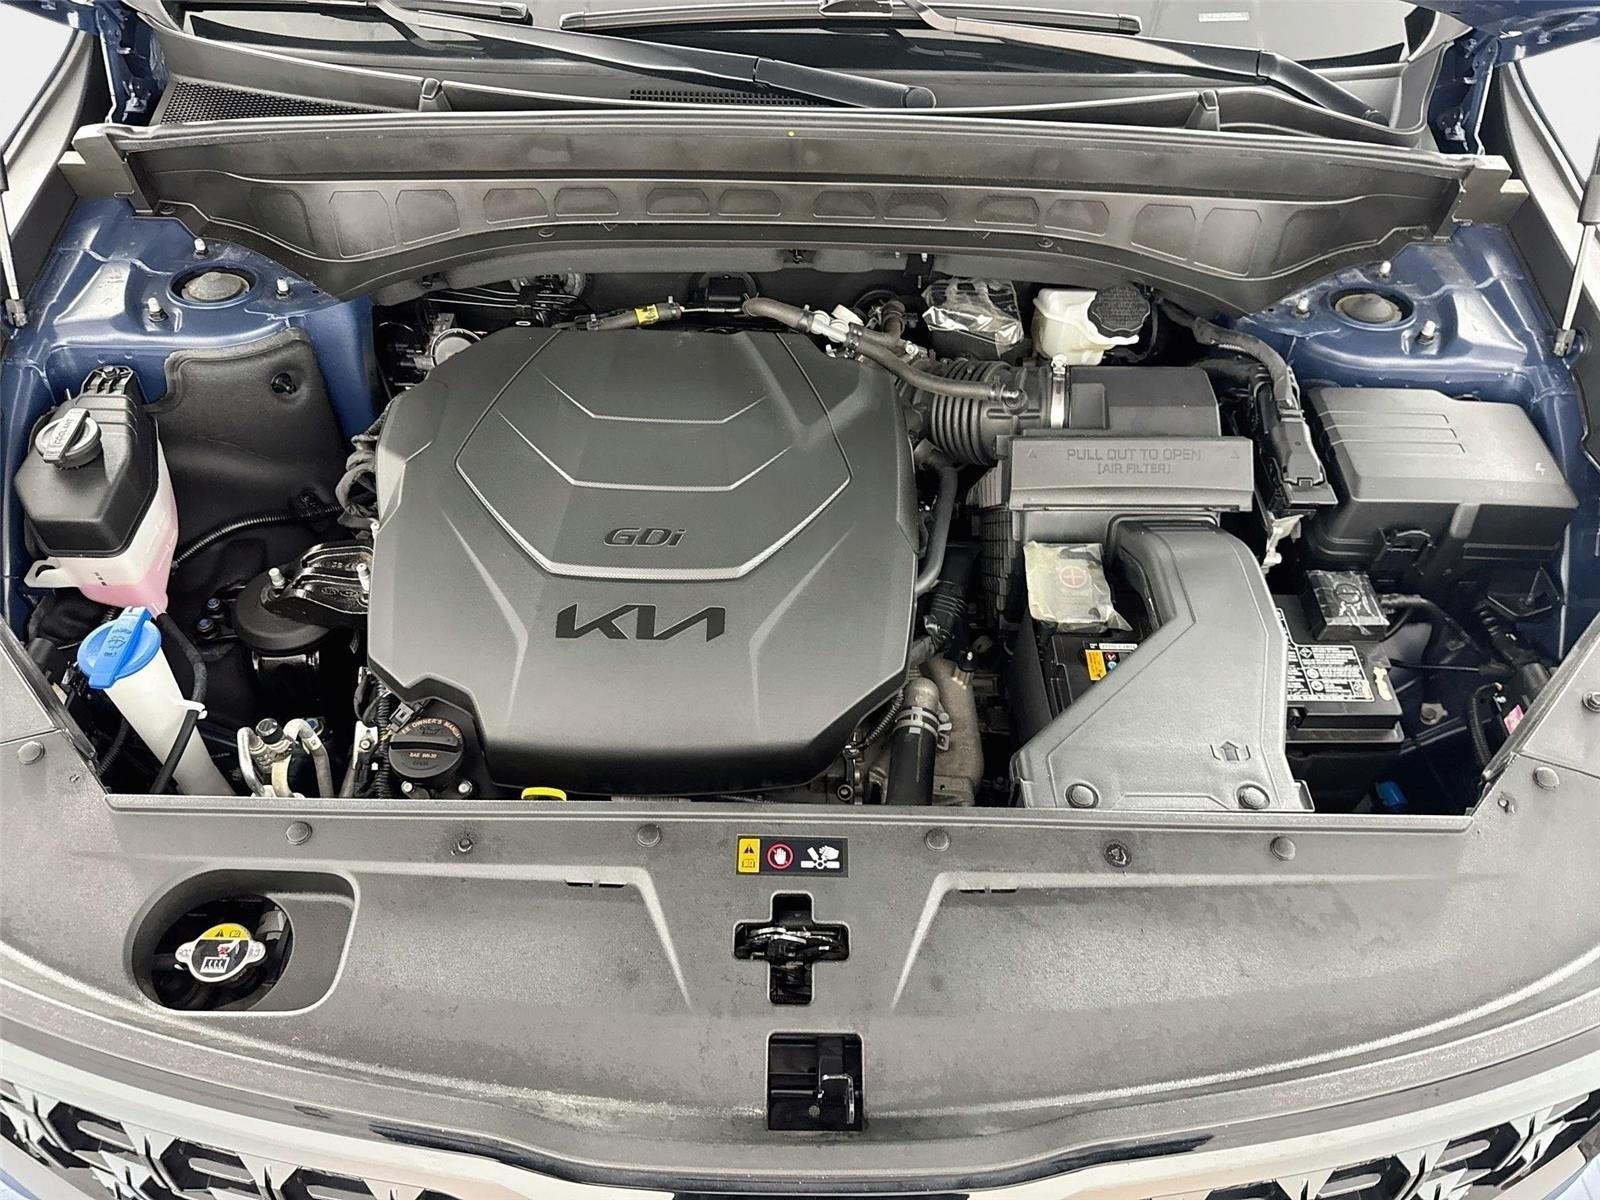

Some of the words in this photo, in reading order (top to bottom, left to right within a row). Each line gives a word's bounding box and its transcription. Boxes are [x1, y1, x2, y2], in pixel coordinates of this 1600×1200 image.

[1067, 448, 1103, 461] PULL
[1106, 448, 1136, 461] OUT
[1141, 448, 1159, 461] TO
[1163, 448, 1202, 461] OPEN
[603, 527, 686, 547] GDi
[555, 602, 726, 642] KIA
[411, 719, 442, 728] OWNER'S
